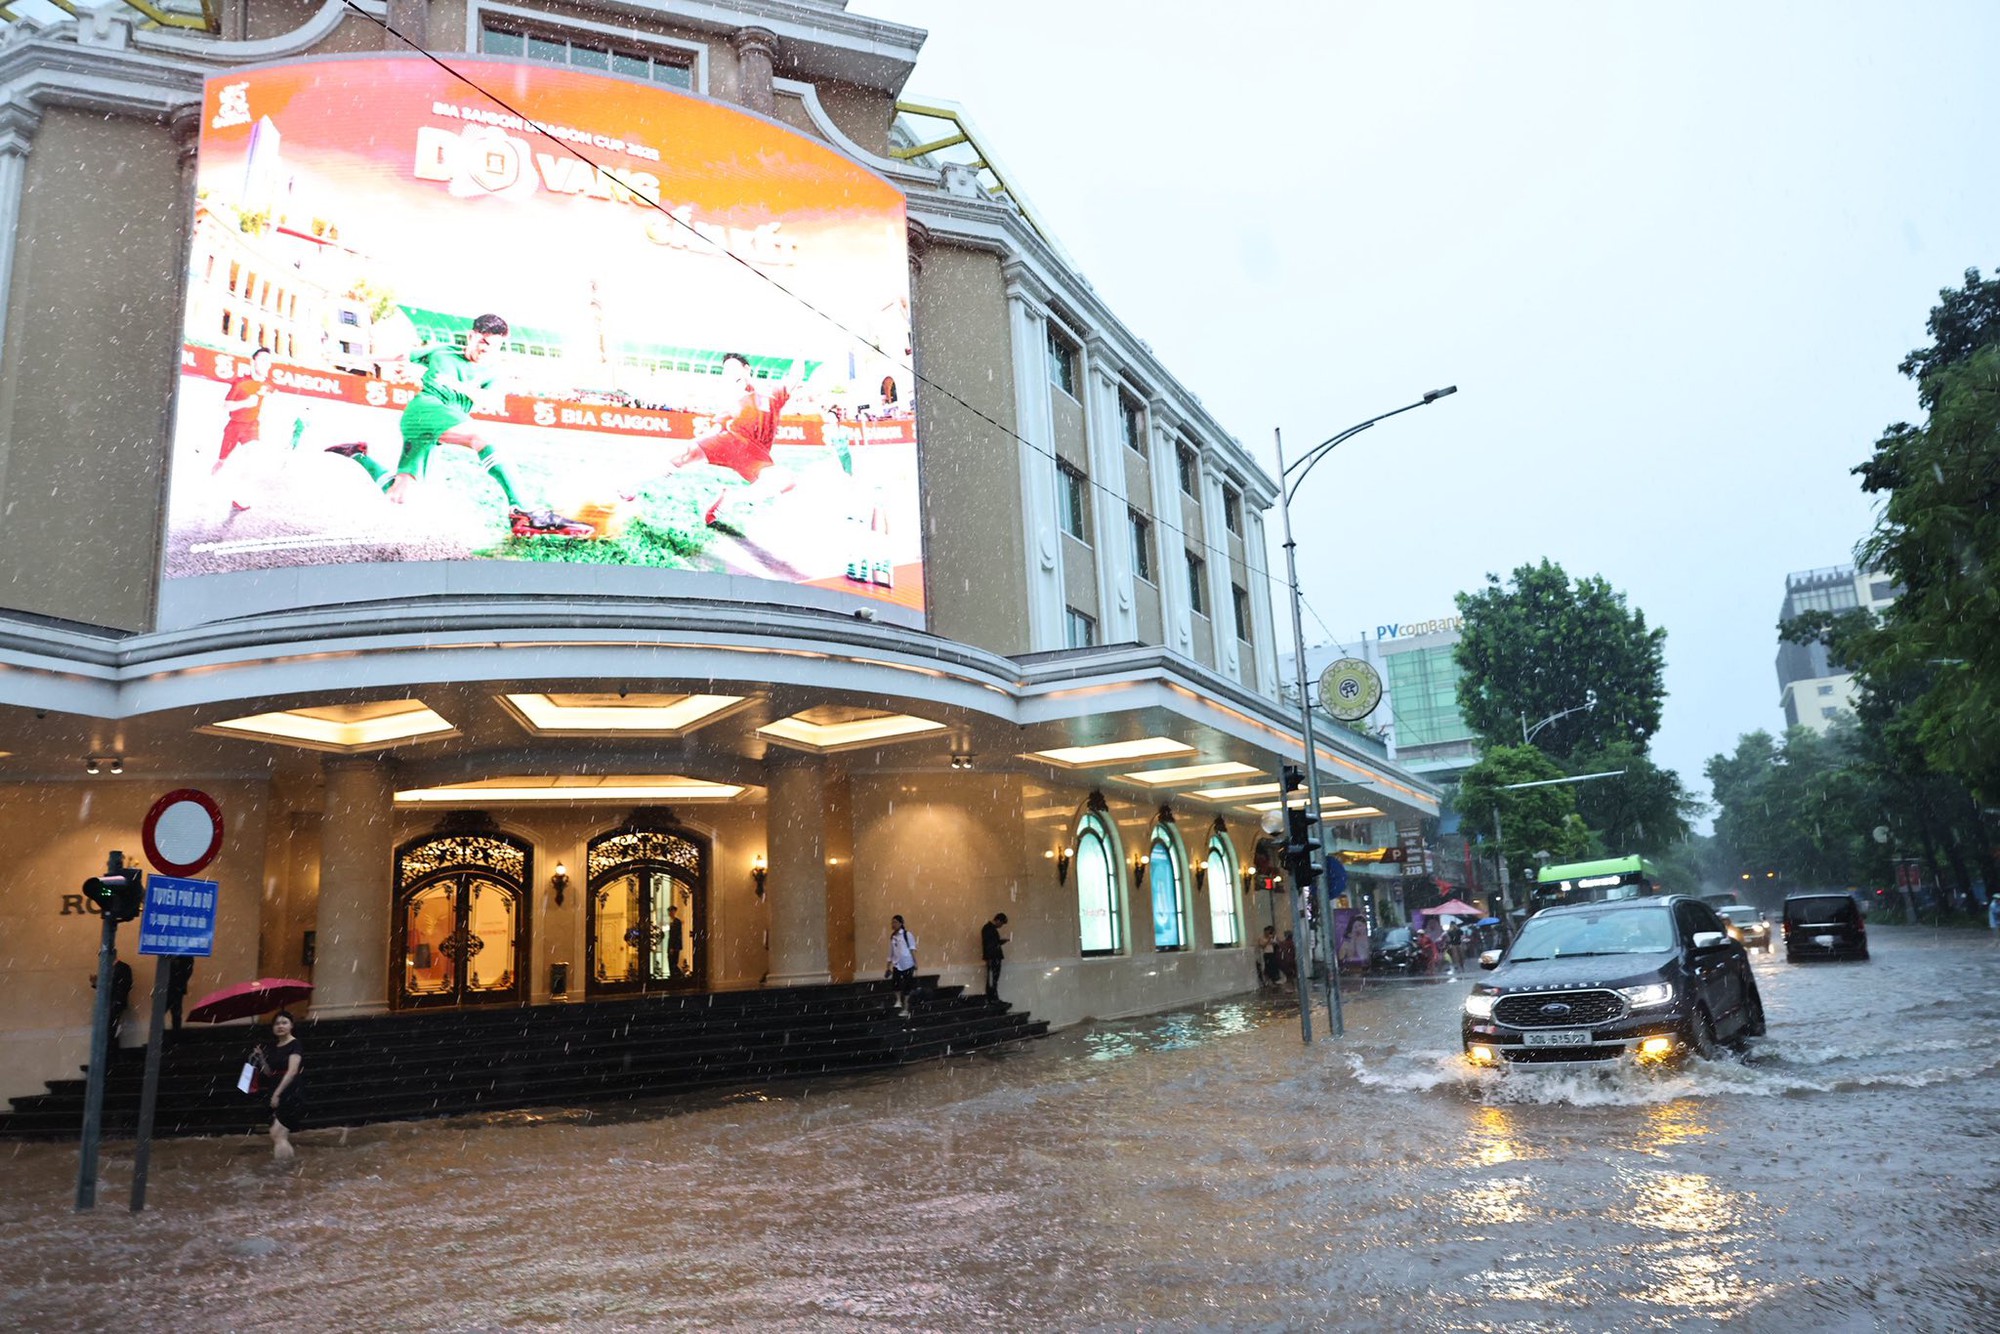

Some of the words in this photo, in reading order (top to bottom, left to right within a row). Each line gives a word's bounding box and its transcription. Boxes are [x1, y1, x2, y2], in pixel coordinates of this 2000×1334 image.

[593, 134, 626, 152] CUP
[561, 408, 598, 427] BIA
[1509, 981, 1601, 991] EVEREST
